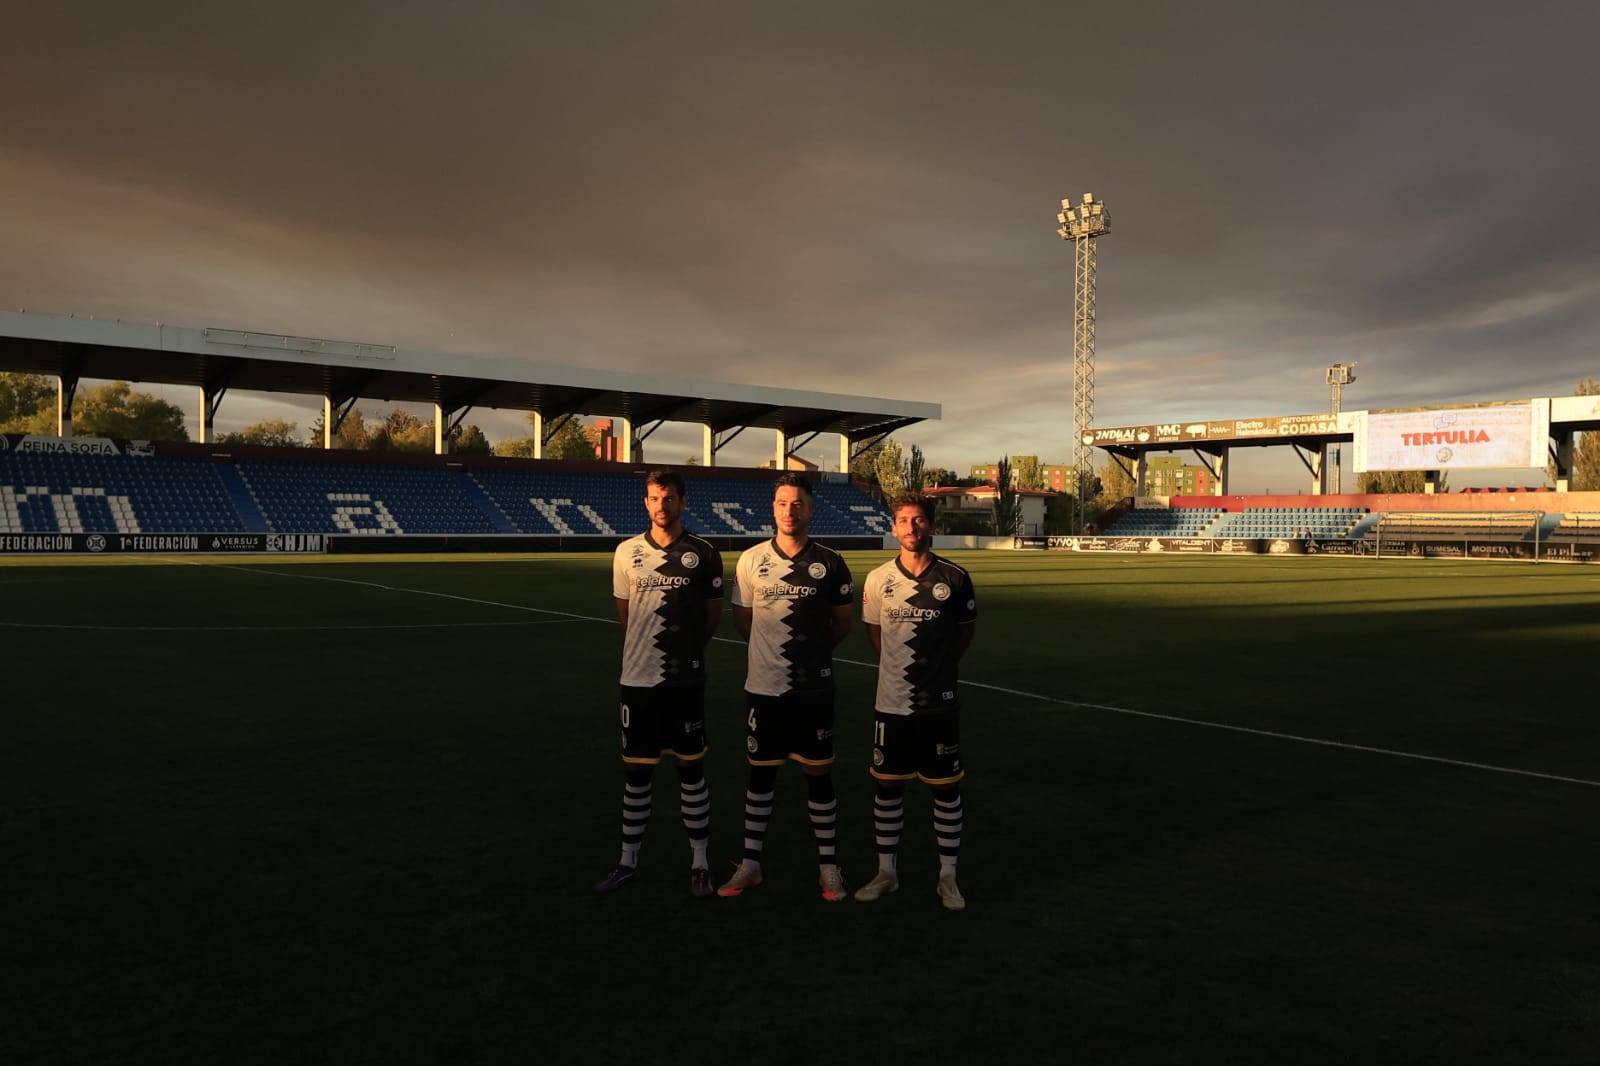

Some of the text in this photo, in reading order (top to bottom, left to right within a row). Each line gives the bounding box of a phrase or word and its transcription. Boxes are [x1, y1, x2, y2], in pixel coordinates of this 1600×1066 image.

[1280, 414, 1336, 423] AUTOESCUELA
[1279, 422, 1337, 435] CODASA
[1401, 429, 1490, 446] TERTULIA
[23, 441, 113, 454] REINA SOFÍA
[0, 535, 73, 550] FEDERACIÓN
[133, 535, 198, 550] FEDERACIÓN
[221, 537, 259, 545] VERSUS
[285, 535, 321, 551] HJM
[1472, 545, 1509, 554] MORETA
[637, 575, 691, 588] telefurgo
[763, 584, 817, 597] telefurgo
[887, 607, 941, 620] telefurgo
[747, 708, 758, 731] 4
